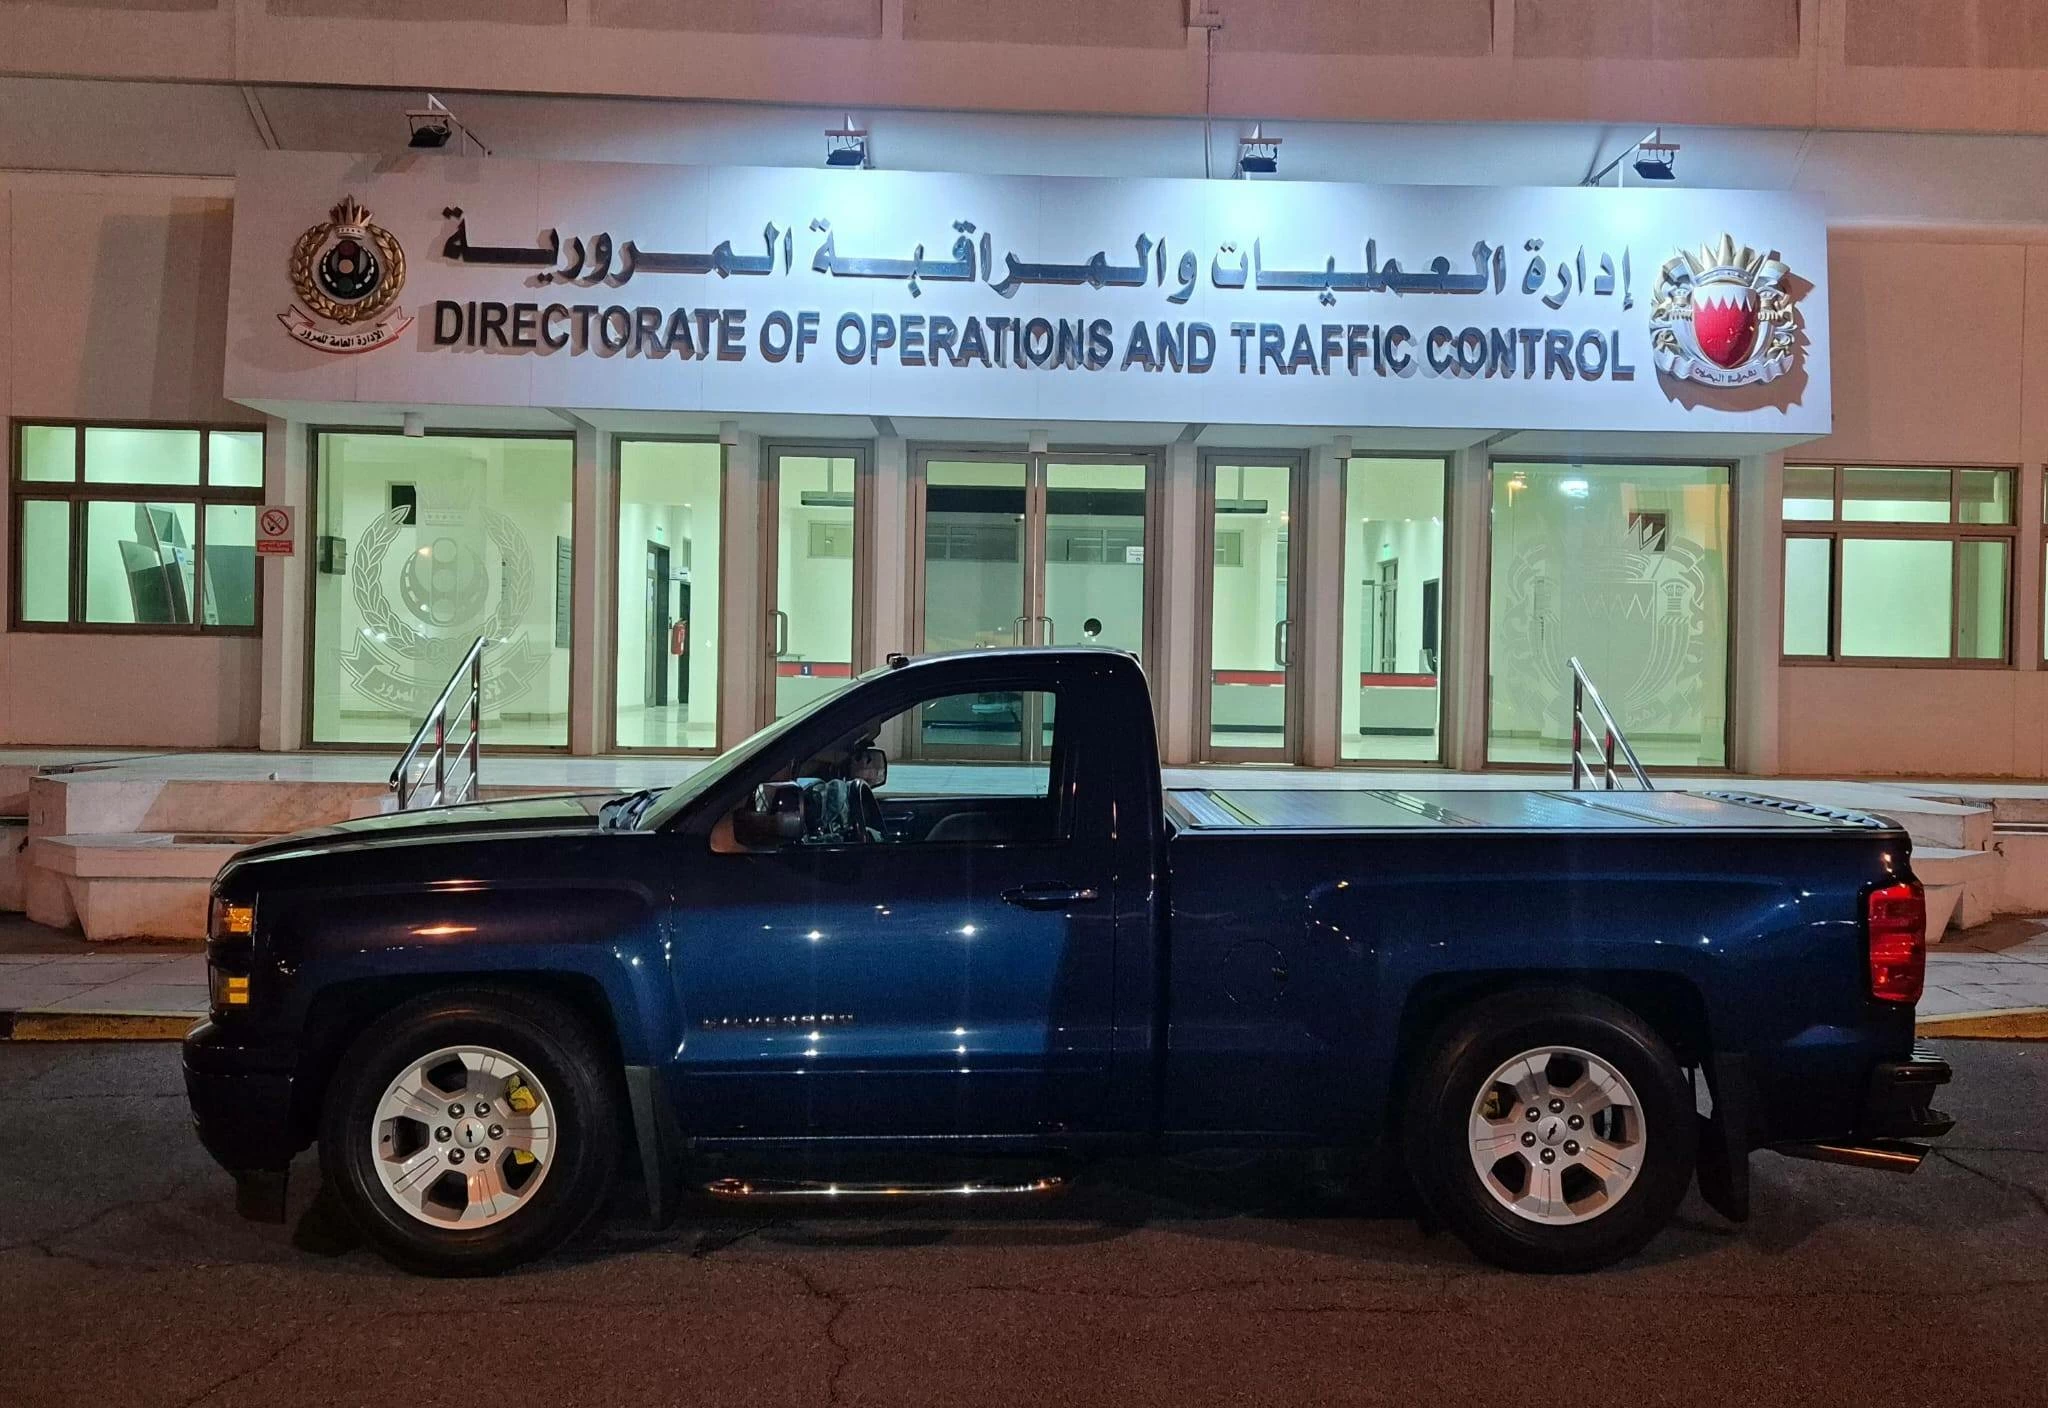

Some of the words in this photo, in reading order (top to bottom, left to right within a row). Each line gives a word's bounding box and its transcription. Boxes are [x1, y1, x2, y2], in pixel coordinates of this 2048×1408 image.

[441, 205, 794, 289] المرورية
[808, 216, 1200, 305] والمراقبة
[1210, 236, 1507, 307] العمليات
[1521, 238, 1633, 311] إدارة
[299, 329, 329, 342] للمرور
[328, 336, 355, 348] العامة
[434, 299, 748, 362] DIRECTORATE
[759, 309, 820, 364] OF
[834, 311, 1116, 372] OPERATIONS
[1126, 319, 1218, 374] AND
[1229, 321, 1412, 376] TRAFFIC
[1425, 324, 1636, 381] CONTROL
